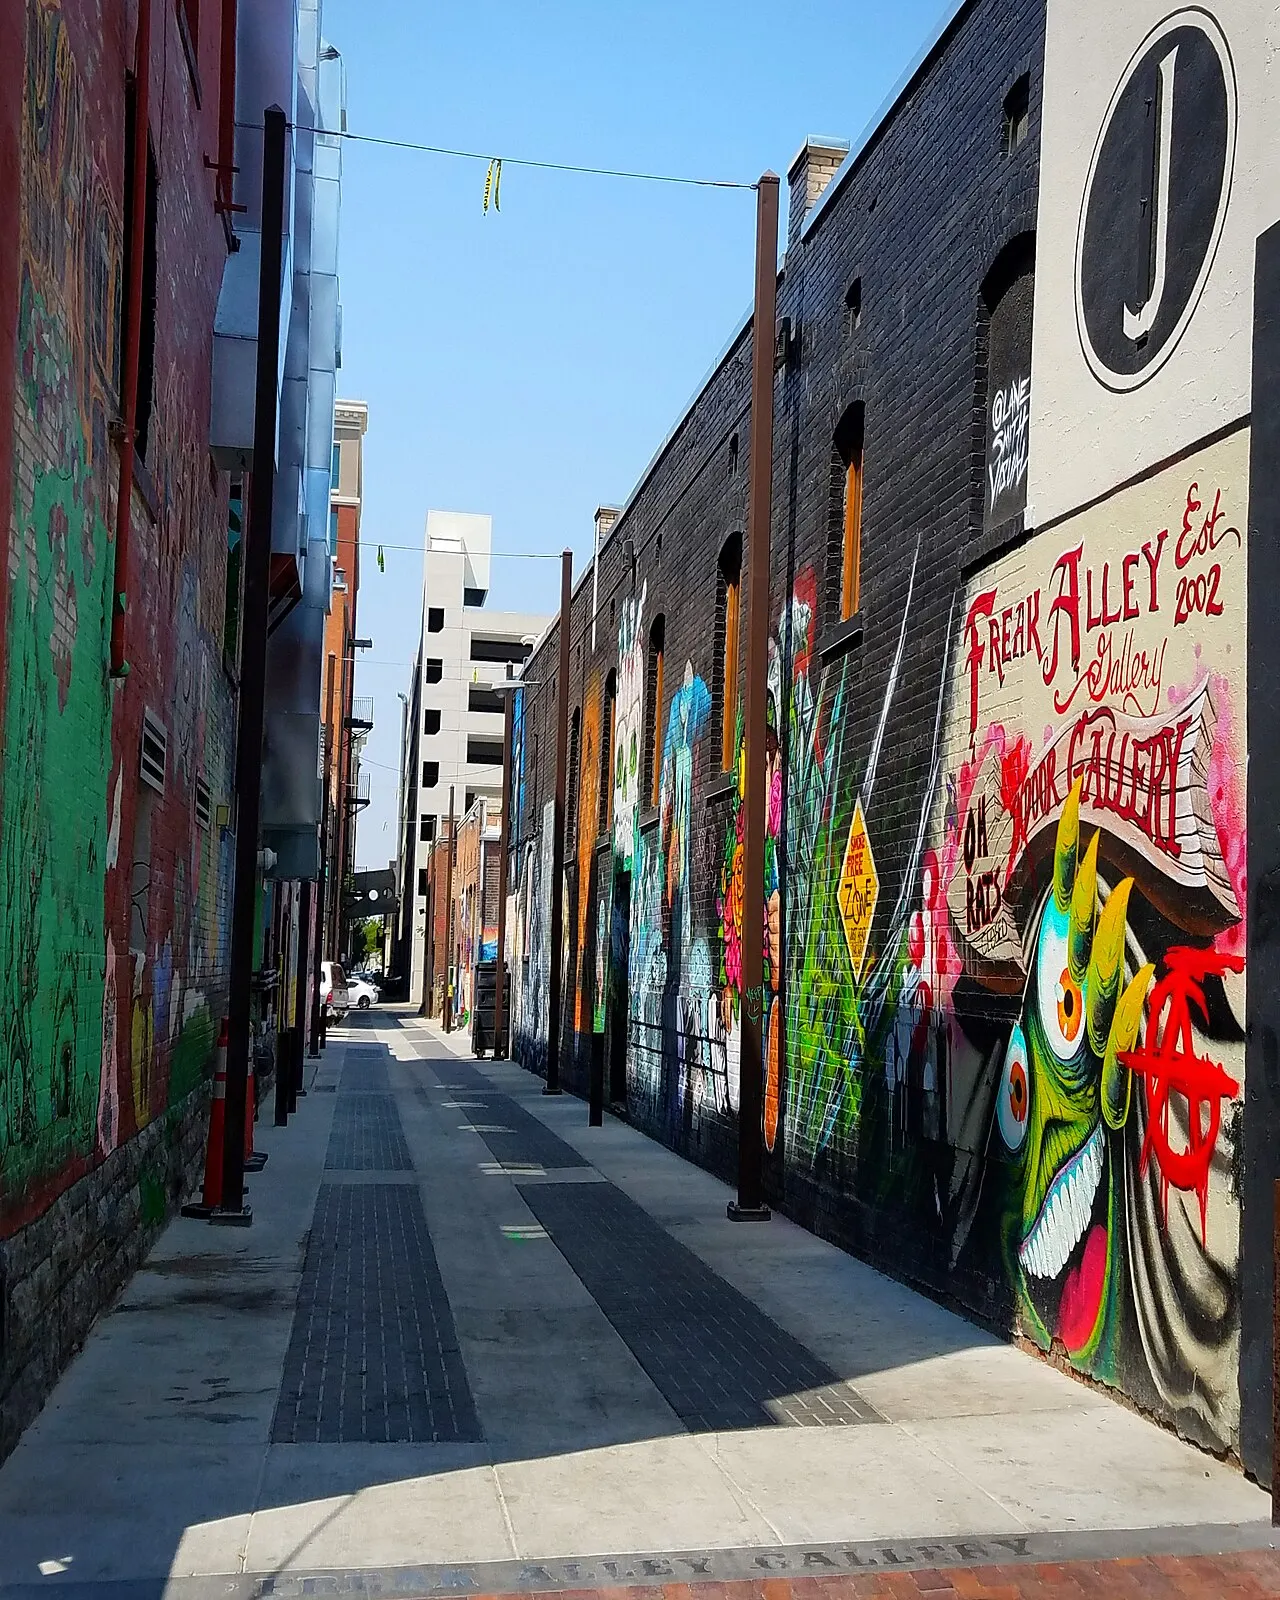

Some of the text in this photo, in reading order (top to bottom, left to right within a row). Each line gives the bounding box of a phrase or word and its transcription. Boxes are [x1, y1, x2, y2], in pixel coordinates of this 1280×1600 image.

[1122, 44, 1180, 342] J
[1041, 529, 1170, 682] ALLEY
[1174, 563, 1225, 628] 2002
[1054, 627, 1169, 716] Gallery
[1066, 706, 1193, 859] GALLERY
[844, 878, 872, 925] ZONE
[846, 852, 863, 877] FREE
[516, 1556, 715, 1586] ALLEY
[750, 1537, 1035, 1572] GALLERY
